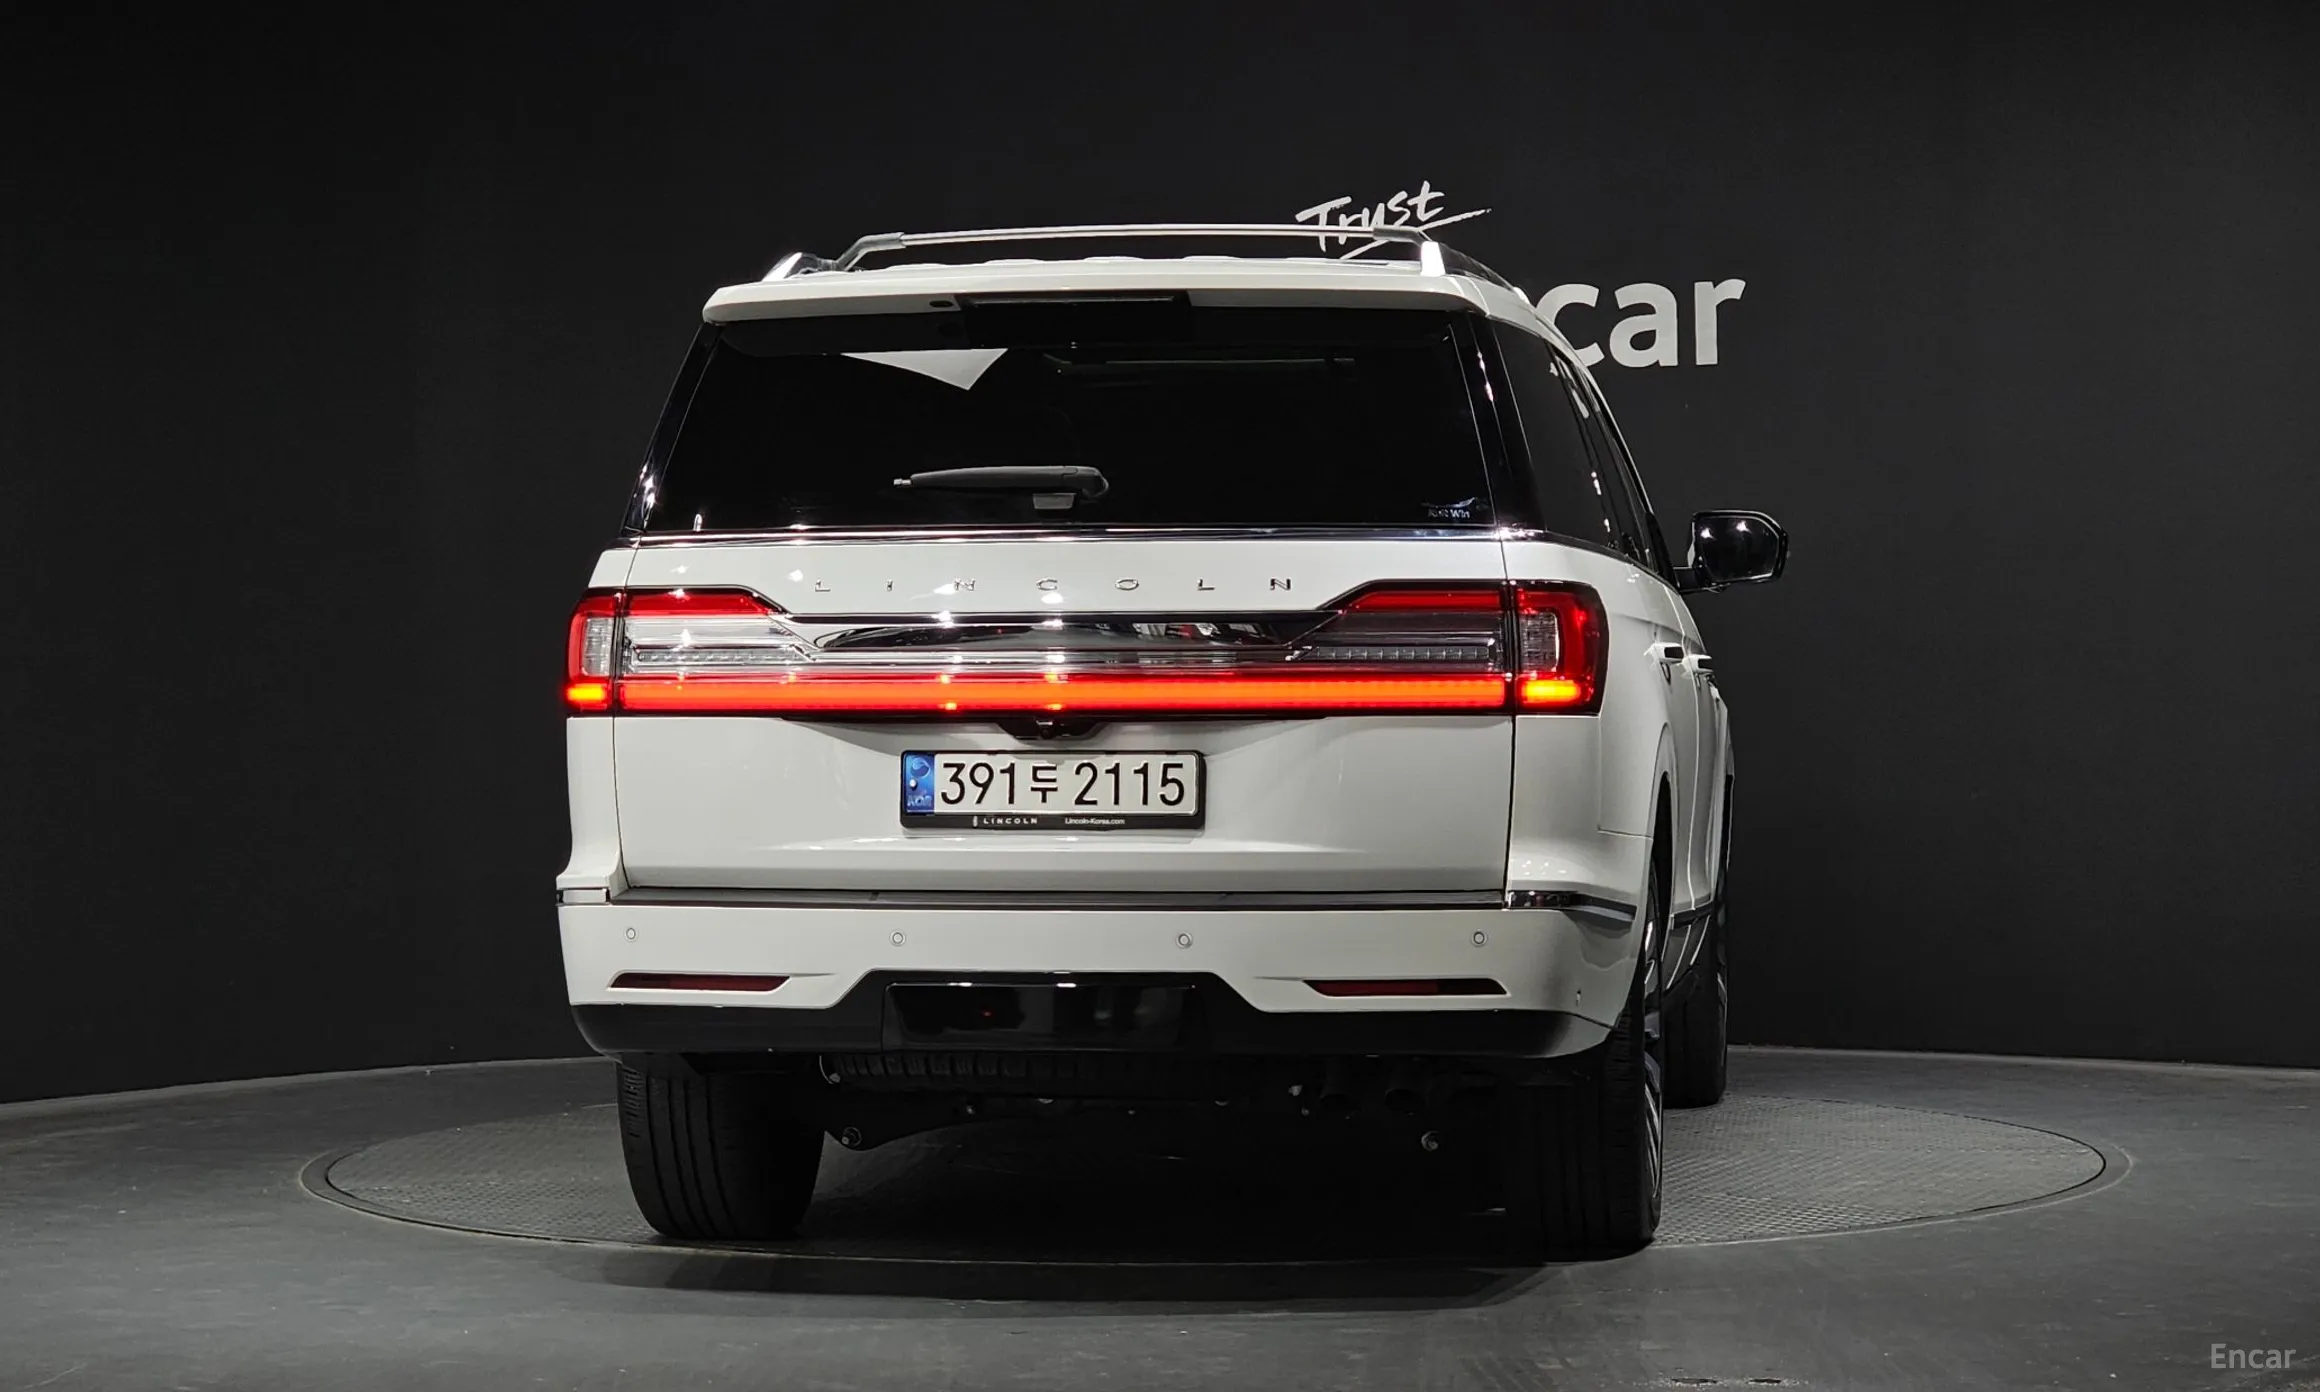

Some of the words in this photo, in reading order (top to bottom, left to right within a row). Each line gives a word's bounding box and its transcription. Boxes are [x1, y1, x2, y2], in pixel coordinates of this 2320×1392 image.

[1295, 180, 1446, 253] Trust
[814, 577, 1292, 593] LINCOLN
[1073, 761, 1185, 807] 2115
[983, 816, 1038, 825] LINCOLN
